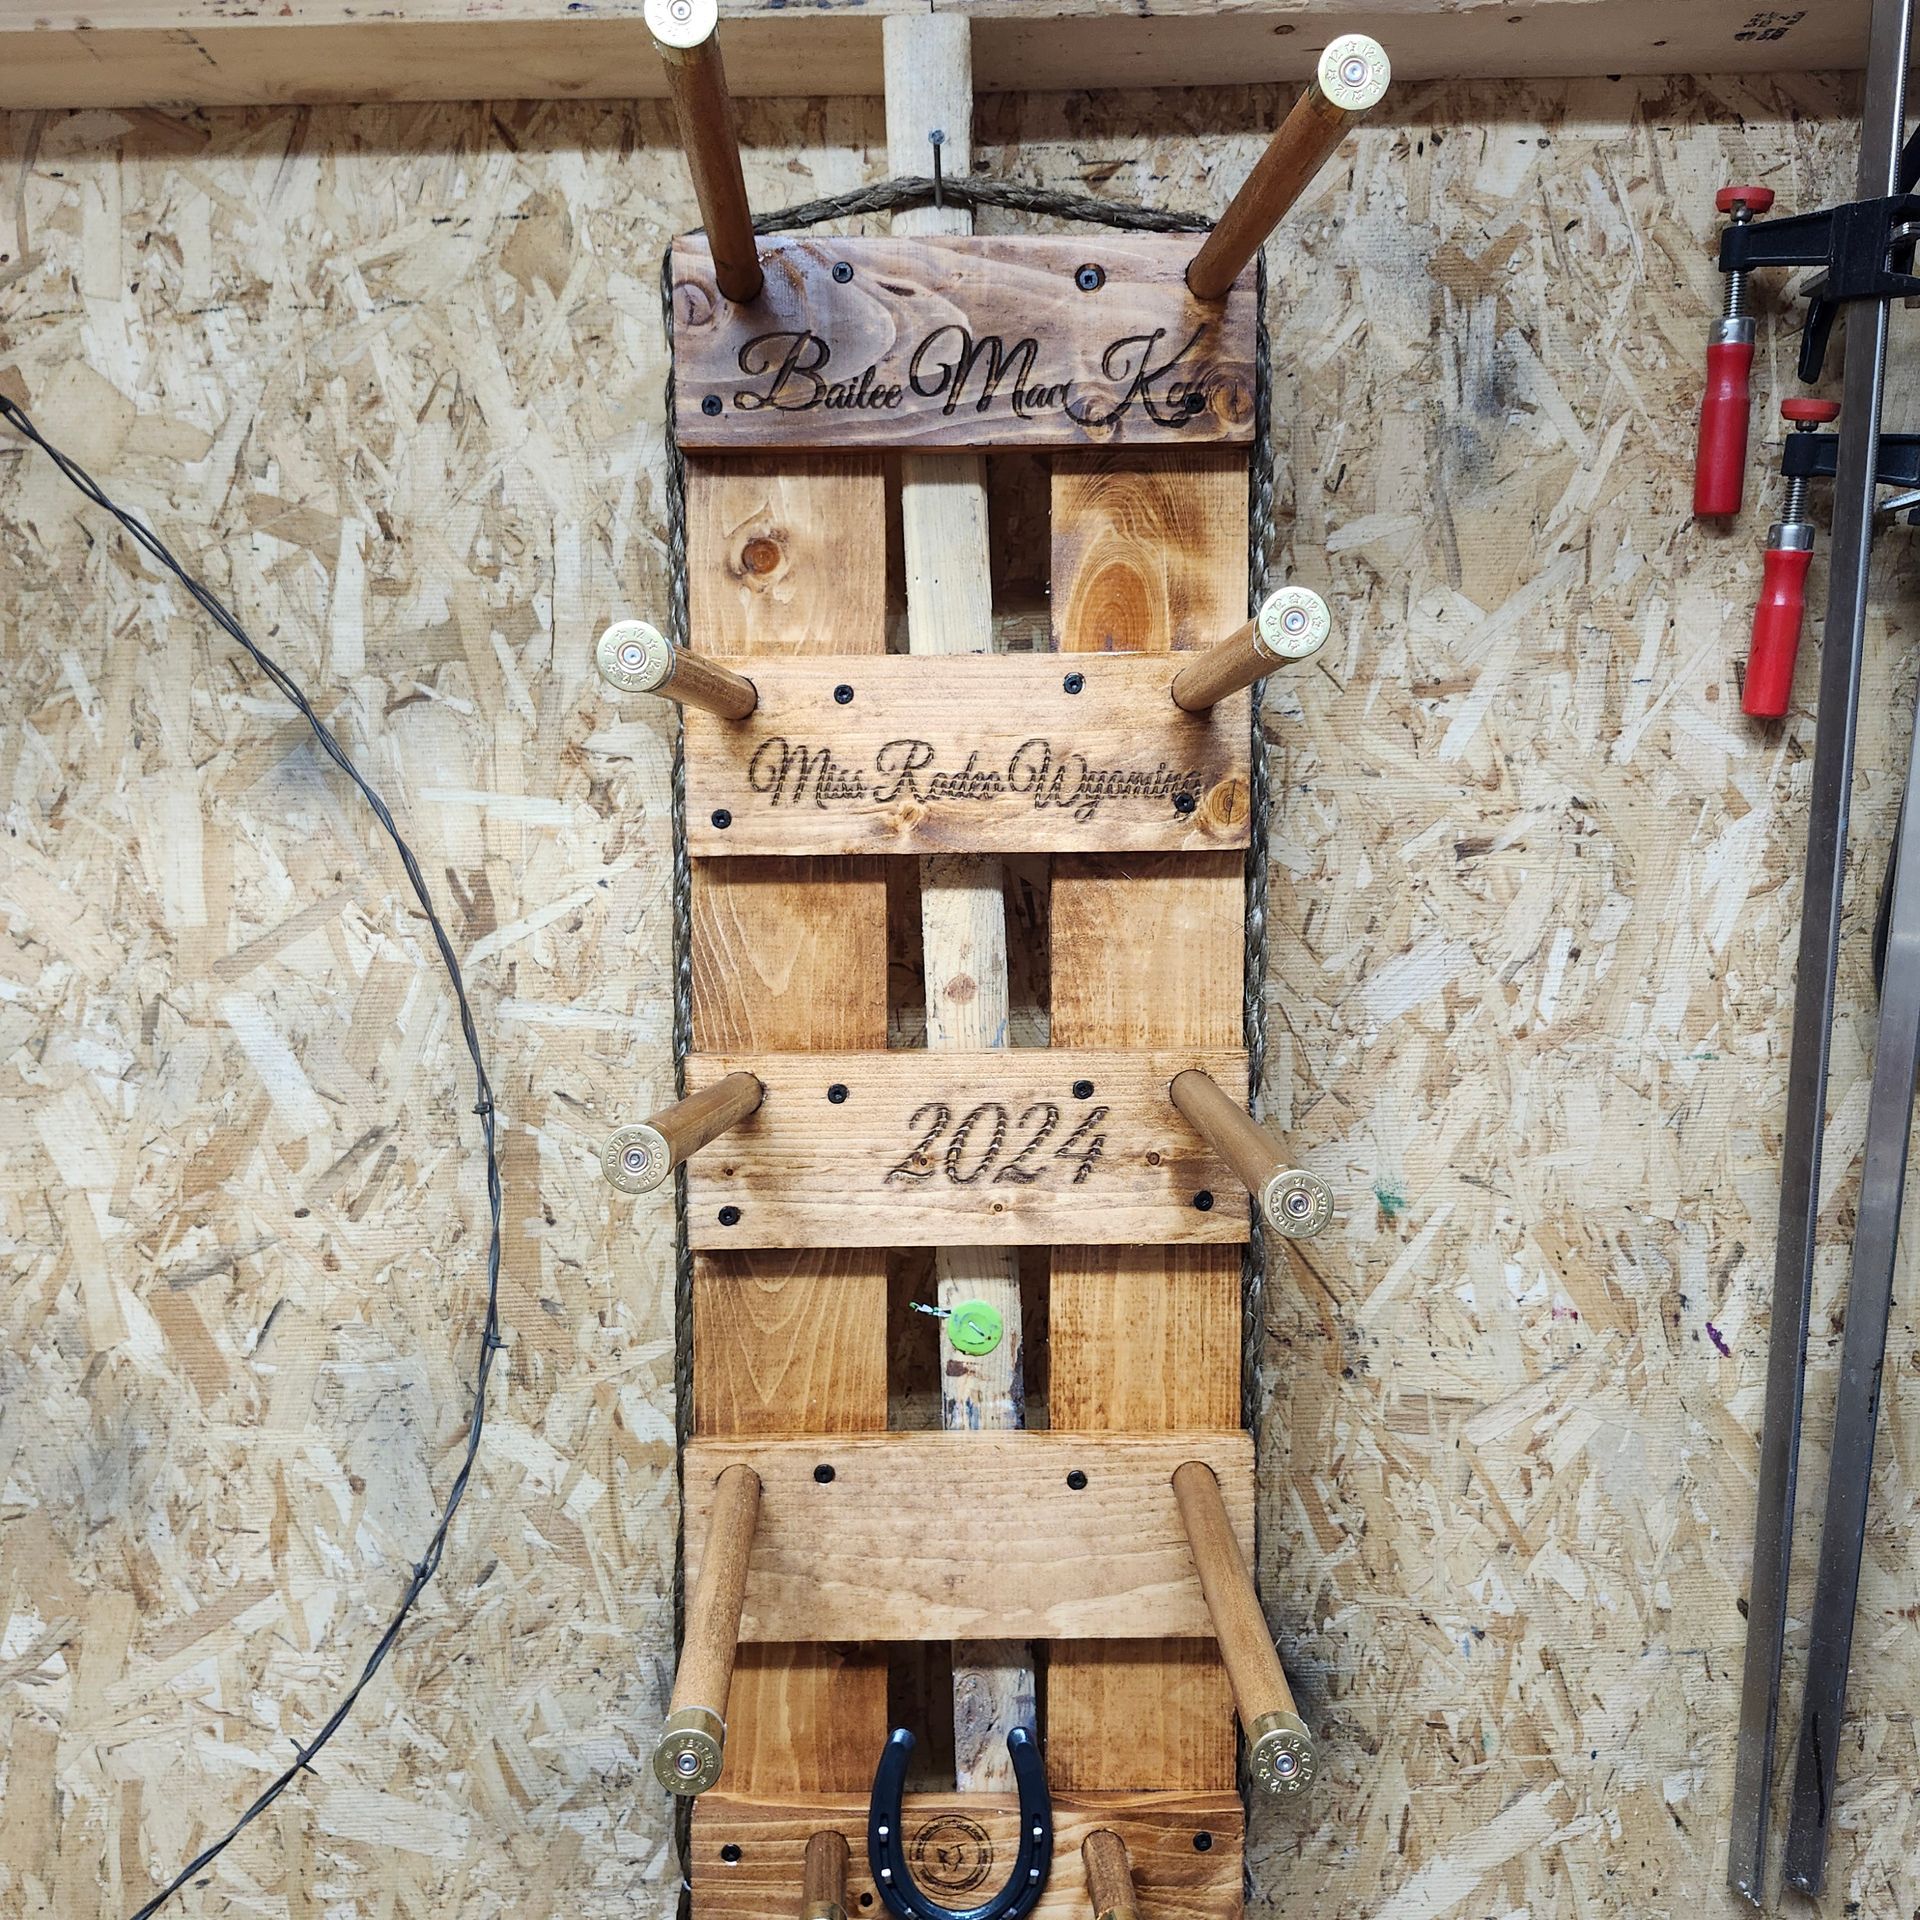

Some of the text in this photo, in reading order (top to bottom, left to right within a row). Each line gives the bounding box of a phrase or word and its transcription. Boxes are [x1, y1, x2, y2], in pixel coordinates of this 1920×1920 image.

[734, 329, 903, 412] Bailee
[748, 737, 867, 810] Miss
[873, 739, 1005, 804] Rodeo
[883, 1101, 1110, 1184] 2024
